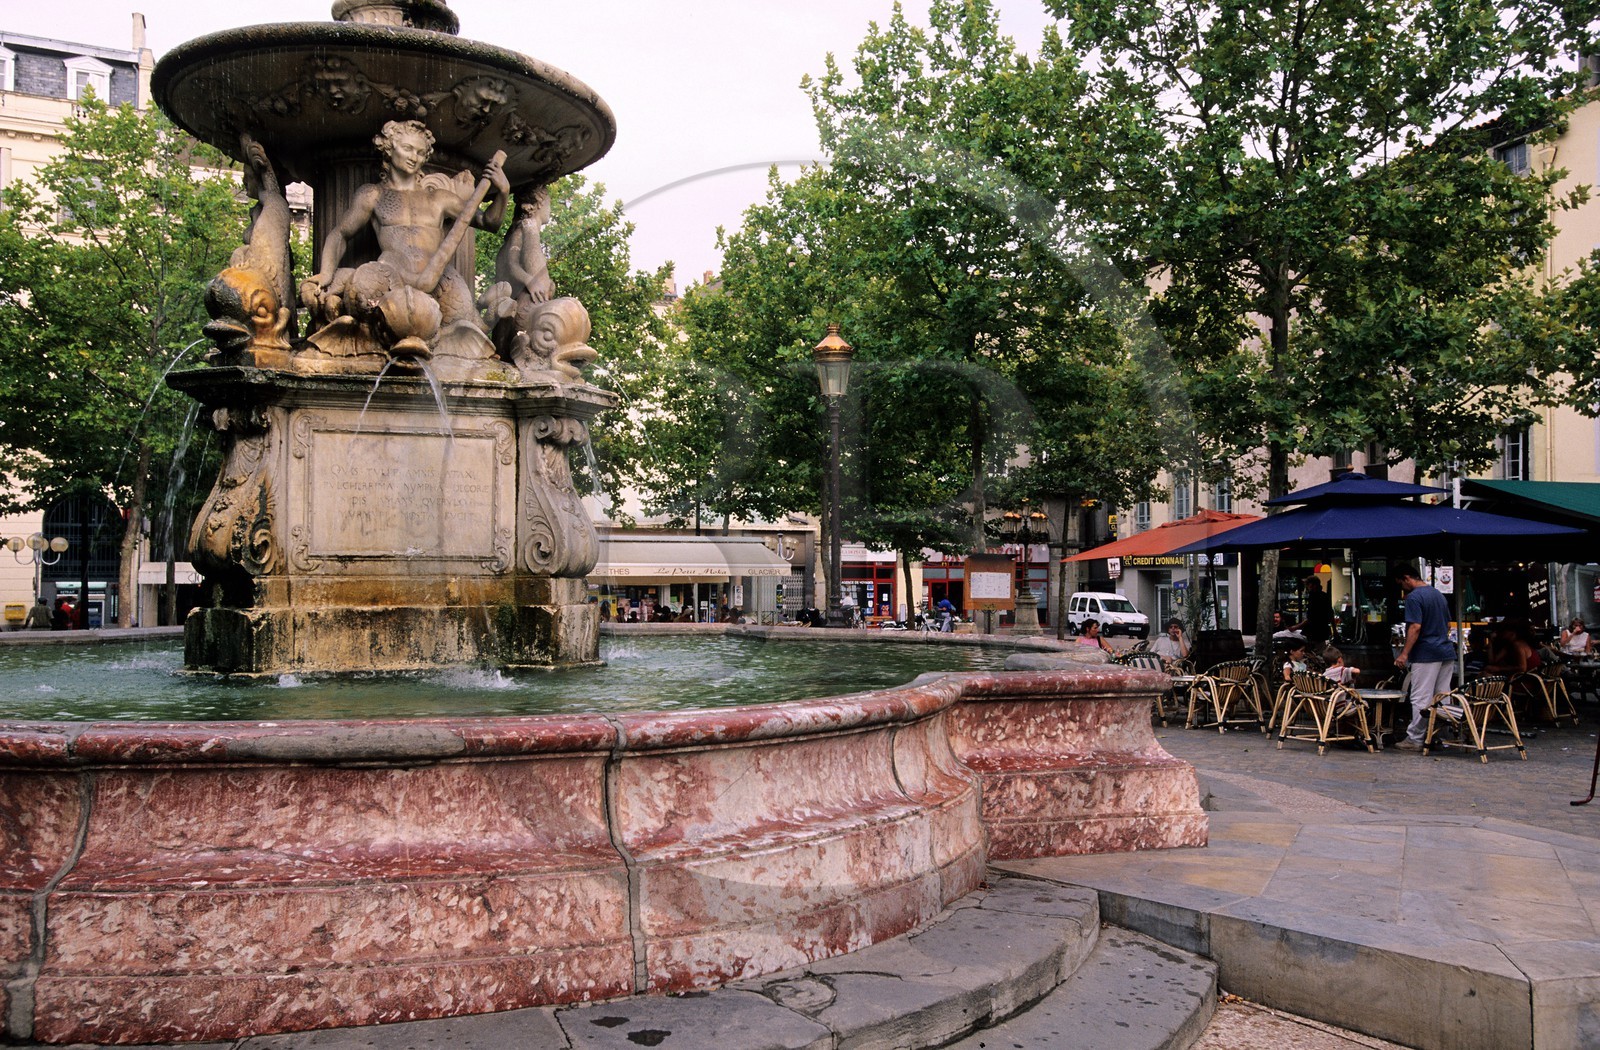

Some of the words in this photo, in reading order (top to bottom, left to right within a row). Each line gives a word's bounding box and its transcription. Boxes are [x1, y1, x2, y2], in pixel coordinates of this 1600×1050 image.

[1133, 557, 1154, 566] CREDIT
[1155, 556, 1184, 565] LYONNAIS
[747, 568, 781, 576] GLACIER
